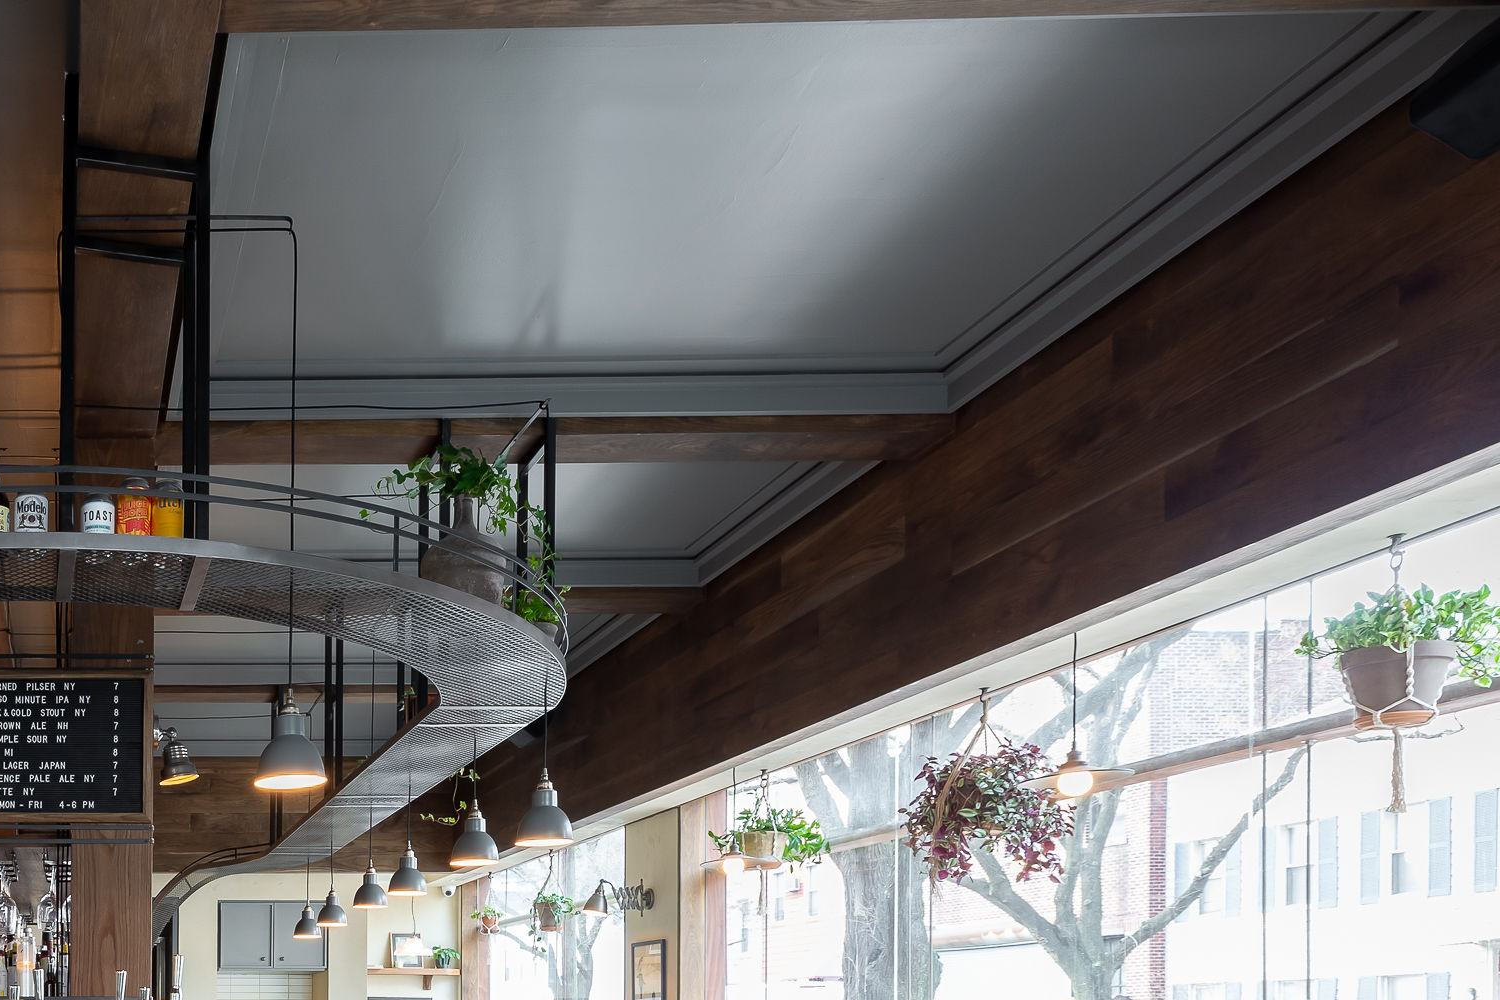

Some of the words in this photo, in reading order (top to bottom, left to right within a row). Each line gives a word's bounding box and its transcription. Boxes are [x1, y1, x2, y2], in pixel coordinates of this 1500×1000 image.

[17, 500, 47, 515] Modelo
[123, 500, 149, 510] JUICE
[83, 510, 113, 522] TOAST
[124, 508, 148, 518] BOMB
[26, 682, 56, 692] PILSER
[63, 682, 76, 691] NY
[113, 682, 119, 691] 7
[14, 695, 47, 705] MINUTE
[55, 695, 70, 704] IPA
[78, 695, 91, 704] NY
[113, 695, 119, 704] 8
[40, 708, 66, 718] STOUT
[74, 708, 86, 717] NY
[113, 708, 120, 717] 8
[30, 721, 47, 731] ALE
[57, 721, 69, 730] NH
[113, 721, 119, 731] 7
[26, 734, 48, 744] SOUR
[56, 734, 67, 744] NY
[113, 734, 119, 744] 8
[4, 748, 14, 757] MI
[112, 747, 119, 757] 8
[2, 761, 30, 770] LAGER
[38, 761, 66, 770] JAPAN
[112, 760, 118, 770] 7
[28, 773, 51, 783] PALE
[58, 774, 76, 783] ALE
[83, 774, 96, 783] NY
[112, 774, 118, 784] 7
[22, 787, 35, 796] NY
[112, 787, 118, 797] 7
[58, 800, 77, 809] 4-6
[82, 800, 95, 809] PM
